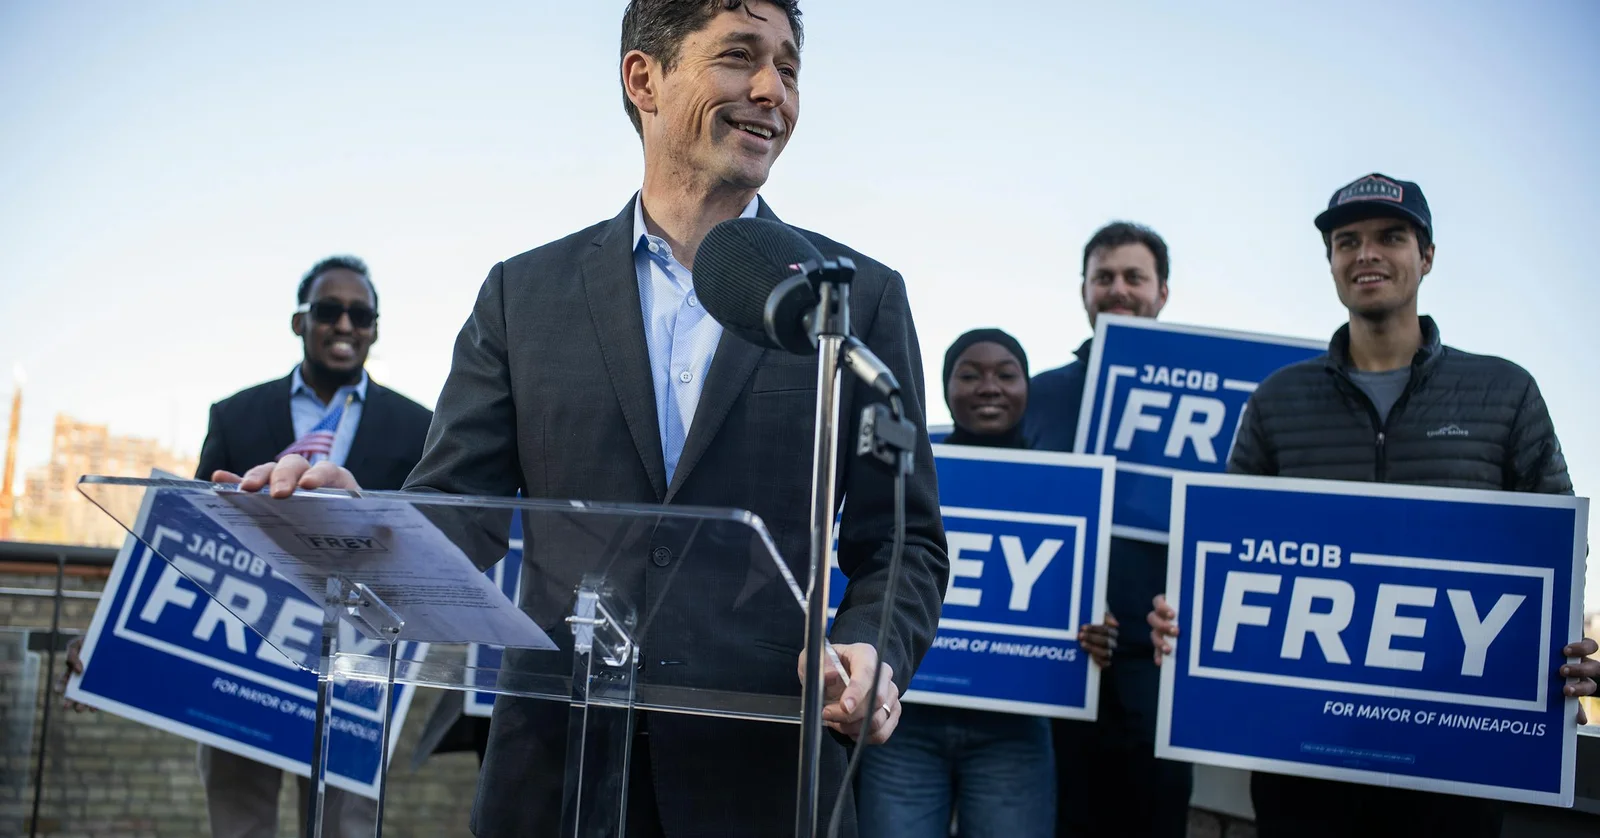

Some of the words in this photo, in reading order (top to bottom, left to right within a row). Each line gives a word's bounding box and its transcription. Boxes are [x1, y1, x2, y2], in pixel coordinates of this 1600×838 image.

[1140, 364, 1219, 392] JACOB
[1113, 388, 1247, 464] FR
[186, 533, 266, 577] JACOB
[308, 536, 373, 549] FREY
[1238, 538, 1342, 568] JACOB
[944, 530, 1064, 611] EY
[1212, 571, 1527, 677] FREY
[969, 639, 989, 653] OF
[989, 641, 1077, 662] MINNEAPOLIS
[212, 677, 238, 696] FOR
[238, 686, 280, 710] MAYOR
[279, 699, 299, 714] OF
[1323, 701, 1354, 717] FOR
[1356, 704, 1411, 723] MAYOR
[1414, 710, 1437, 726] OF
[1438, 713, 1547, 737] MINNEAPOLIS
